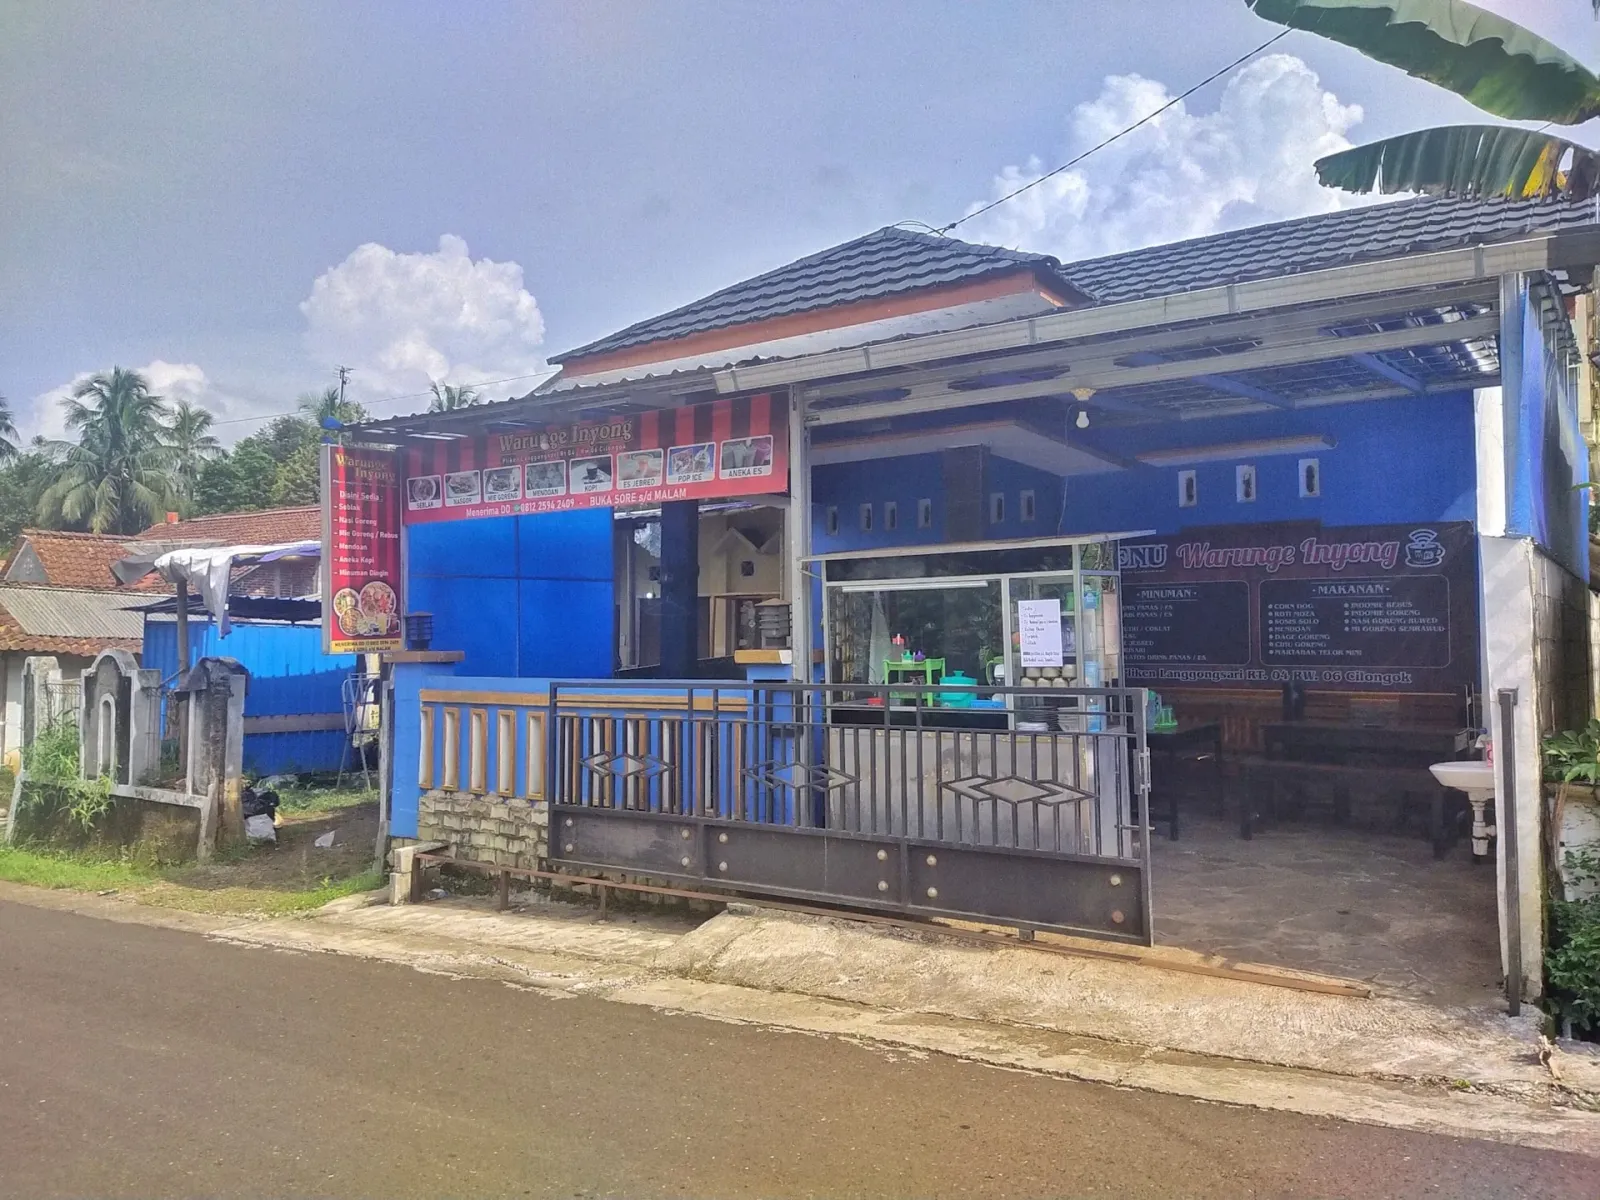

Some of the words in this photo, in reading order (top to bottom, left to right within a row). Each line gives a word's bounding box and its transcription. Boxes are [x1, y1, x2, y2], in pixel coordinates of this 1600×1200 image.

[499, 431, 567, 451] Waruge
[571, 420, 632, 446] Inyong
[728, 469, 751, 478] ANEKA
[753, 467, 763, 475] ES
[632, 479, 655, 488] JEBRED
[532, 488, 559, 497] MENDOAN
[338, 503, 361, 511] Seblak
[416, 501, 434, 509] SEBLAK
[466, 505, 499, 518] Menerima
[500, 504, 511, 514] DO
[520, 502, 537, 513] 0812
[538, 500, 555, 511] 2594
[557, 499, 574, 509] 2409
[590, 494, 612, 506] BUKA
[614, 493, 636, 505] SORE
[639, 490, 652, 502] s/d
[655, 488, 687, 500] MALAM
[338, 516, 354, 524] Nasi
[355, 517, 377, 527] Goreng
[338, 529, 350, 537] Mie
[351, 530, 375, 540] Goreng
[380, 531, 399, 539] Rebus
[339, 543, 368, 551] Mendoan
[1175, 542, 1295, 573] Warunge
[1300, 537, 1400, 571] Inyong
[360, 557, 375, 565] Kopi
[369, 570, 389, 578] Dingin
[1141, 588, 1192, 599] MINUMAN
[1318, 583, 1384, 595] MAKANAN
[1159, 668, 1244, 682] Langgongsari
[1246, 668, 1269, 681] RT.
[1271, 668, 1290, 681] 04
[1292, 669, 1319, 682] RW.
[1322, 669, 1343, 682] 06
[1345, 669, 1413, 686] Cilongok
